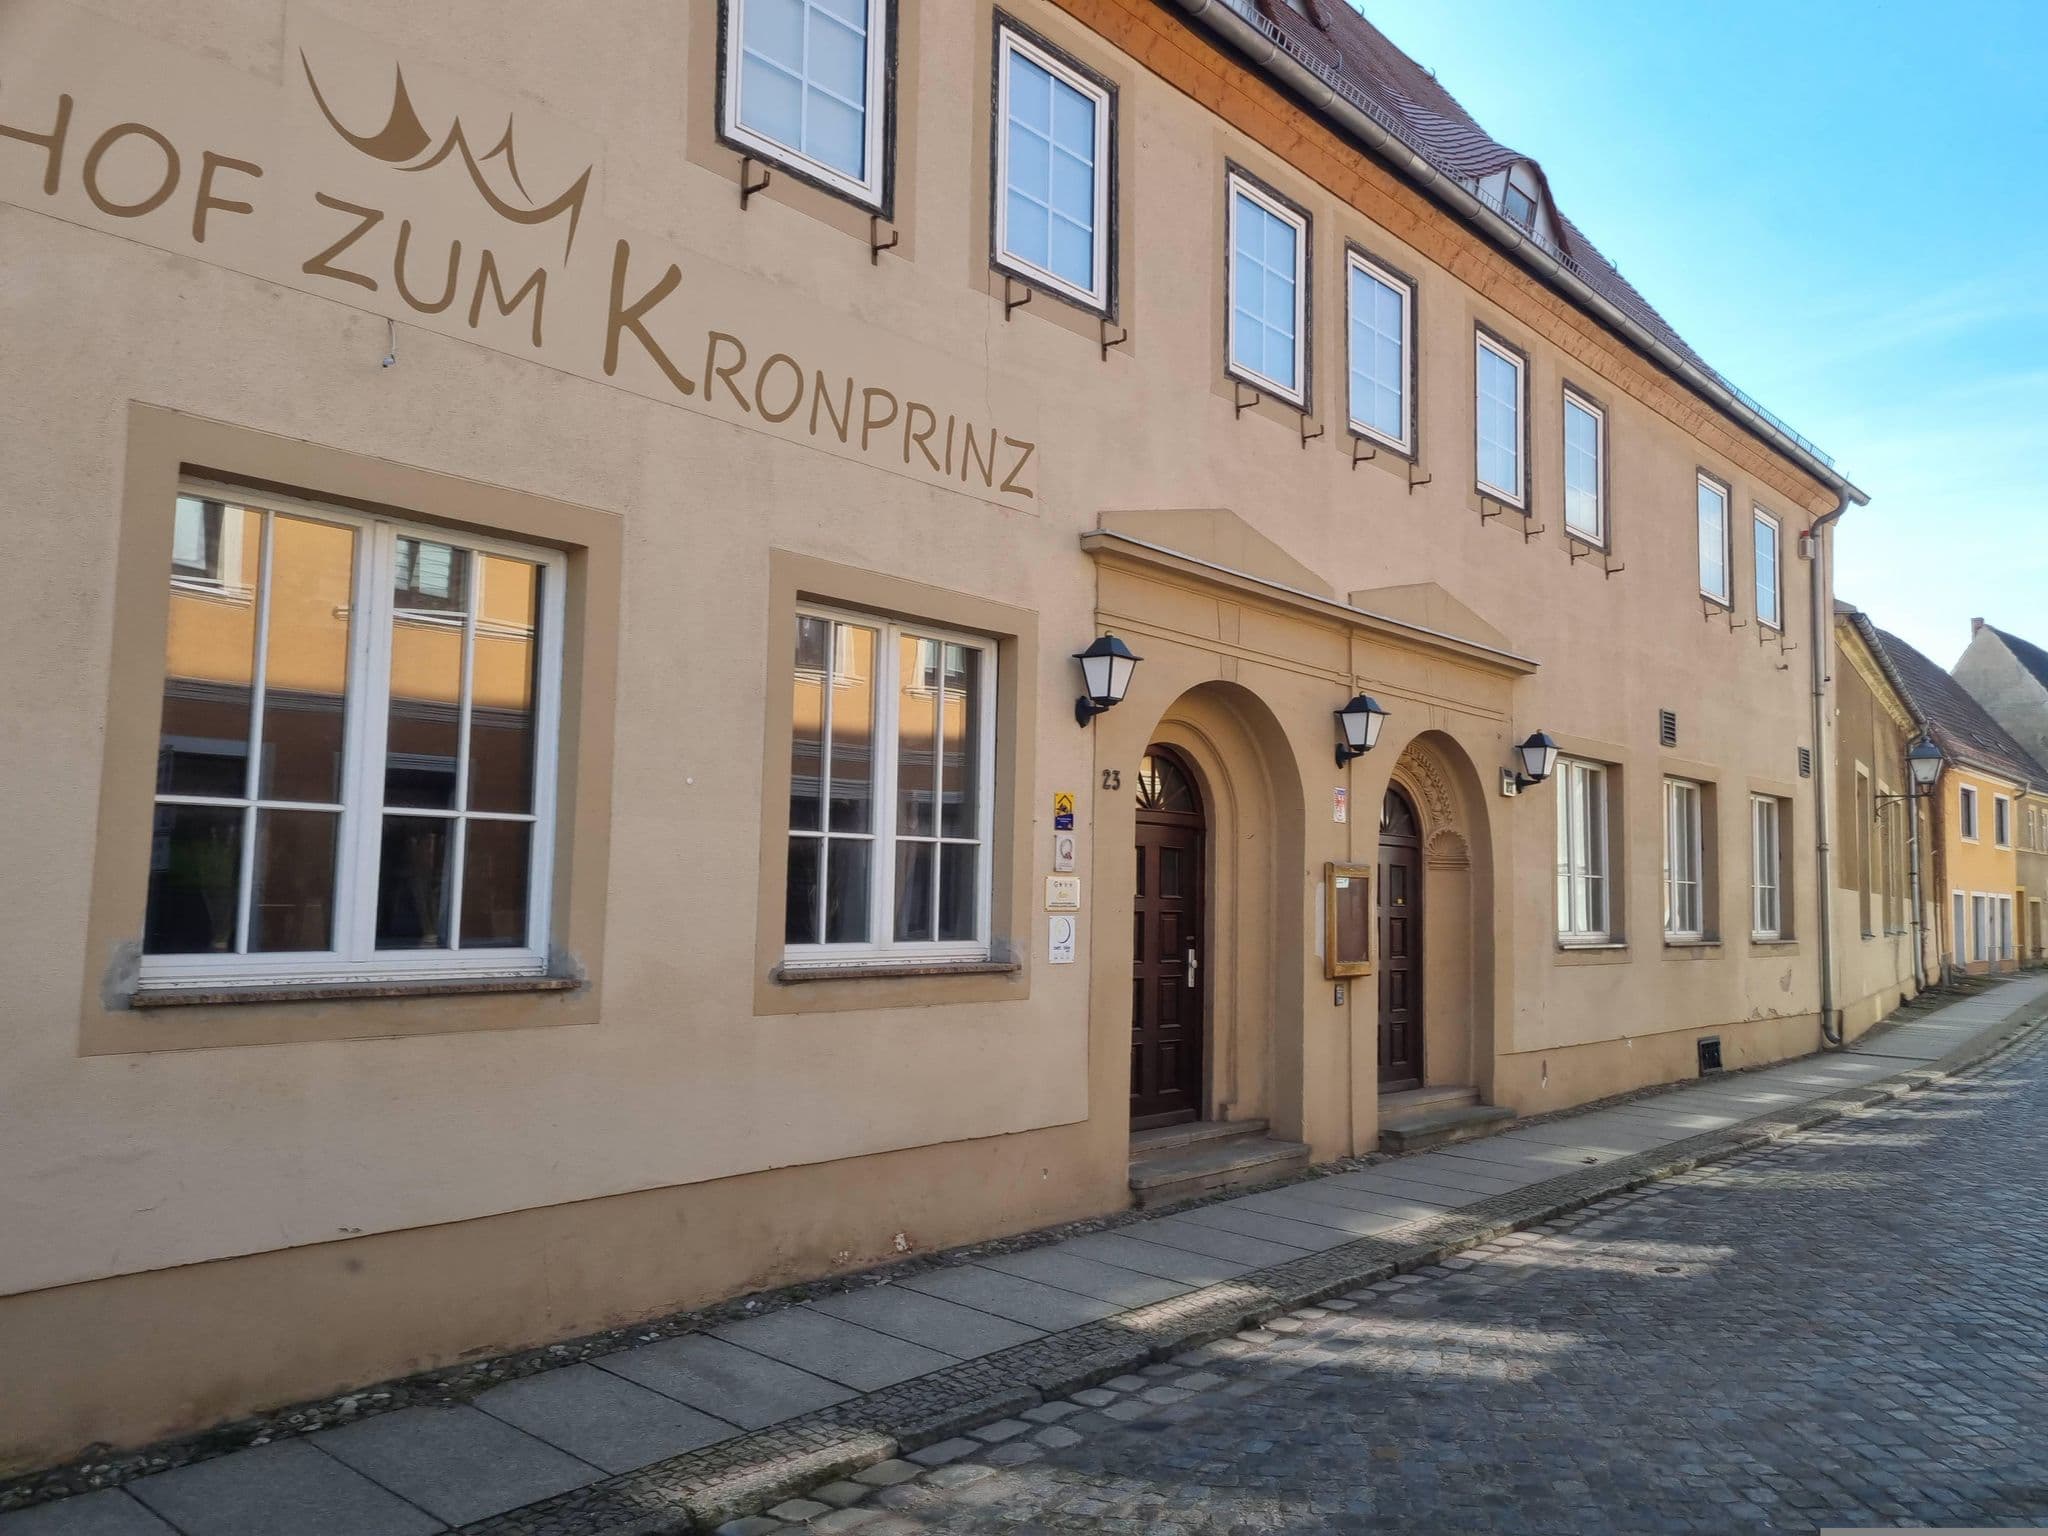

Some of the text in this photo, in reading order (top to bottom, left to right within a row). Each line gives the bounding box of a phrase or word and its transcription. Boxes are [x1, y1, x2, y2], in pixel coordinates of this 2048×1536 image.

[302, 191, 547, 348] ZUM
[603, 238, 1036, 499] KRONPRINZ
[1102, 768, 1121, 791] 23
